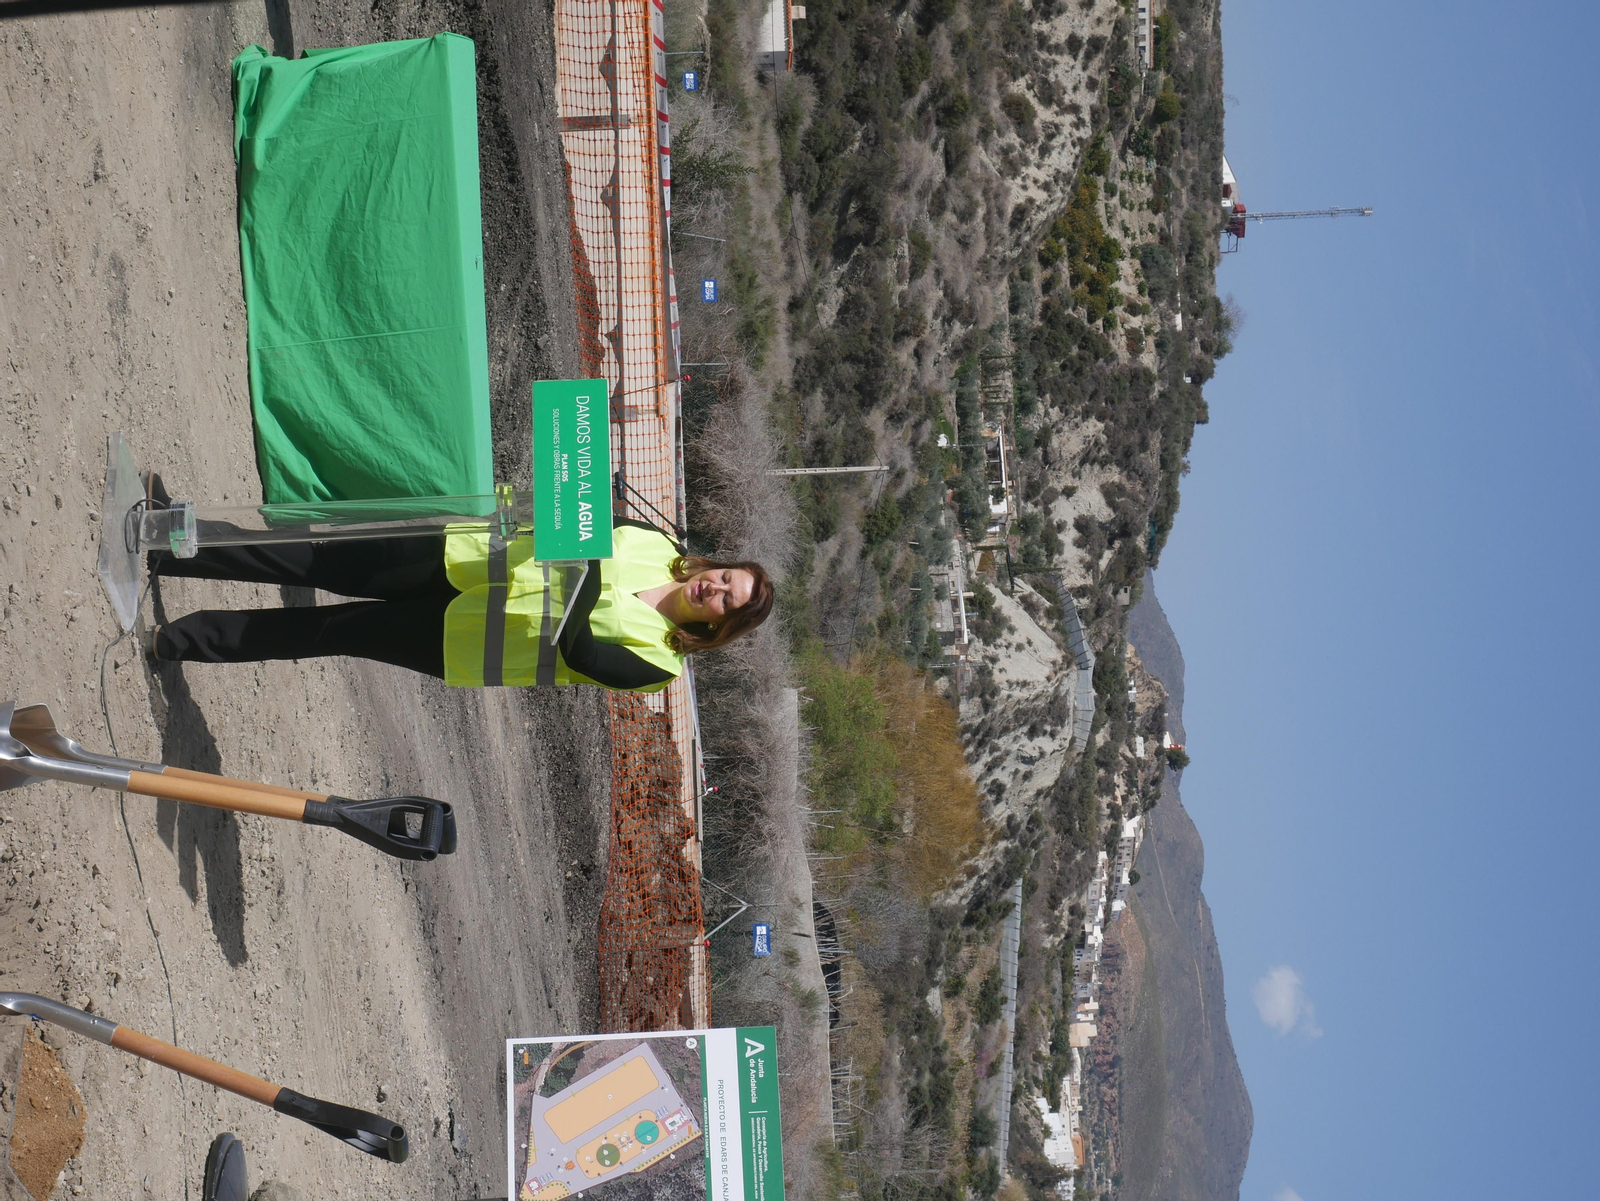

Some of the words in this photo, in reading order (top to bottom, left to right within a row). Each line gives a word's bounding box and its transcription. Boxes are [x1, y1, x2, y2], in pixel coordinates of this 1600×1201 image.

[552, 408, 560, 444] SOLUCIONES
[576, 395, 591, 443] DAMOS
[577, 446, 591, 478] VIDA
[578, 481, 592, 498] AL
[554, 508, 563, 530] SEQUÍA
[578, 501, 593, 541] AGUA
[749, 1059, 755, 1067] de
[718, 1079, 726, 1120] PROYECTO
[750, 1069, 758, 1103] Andalucía
[720, 1123, 726, 1133] DE
[722, 1165, 728, 1174] DE
